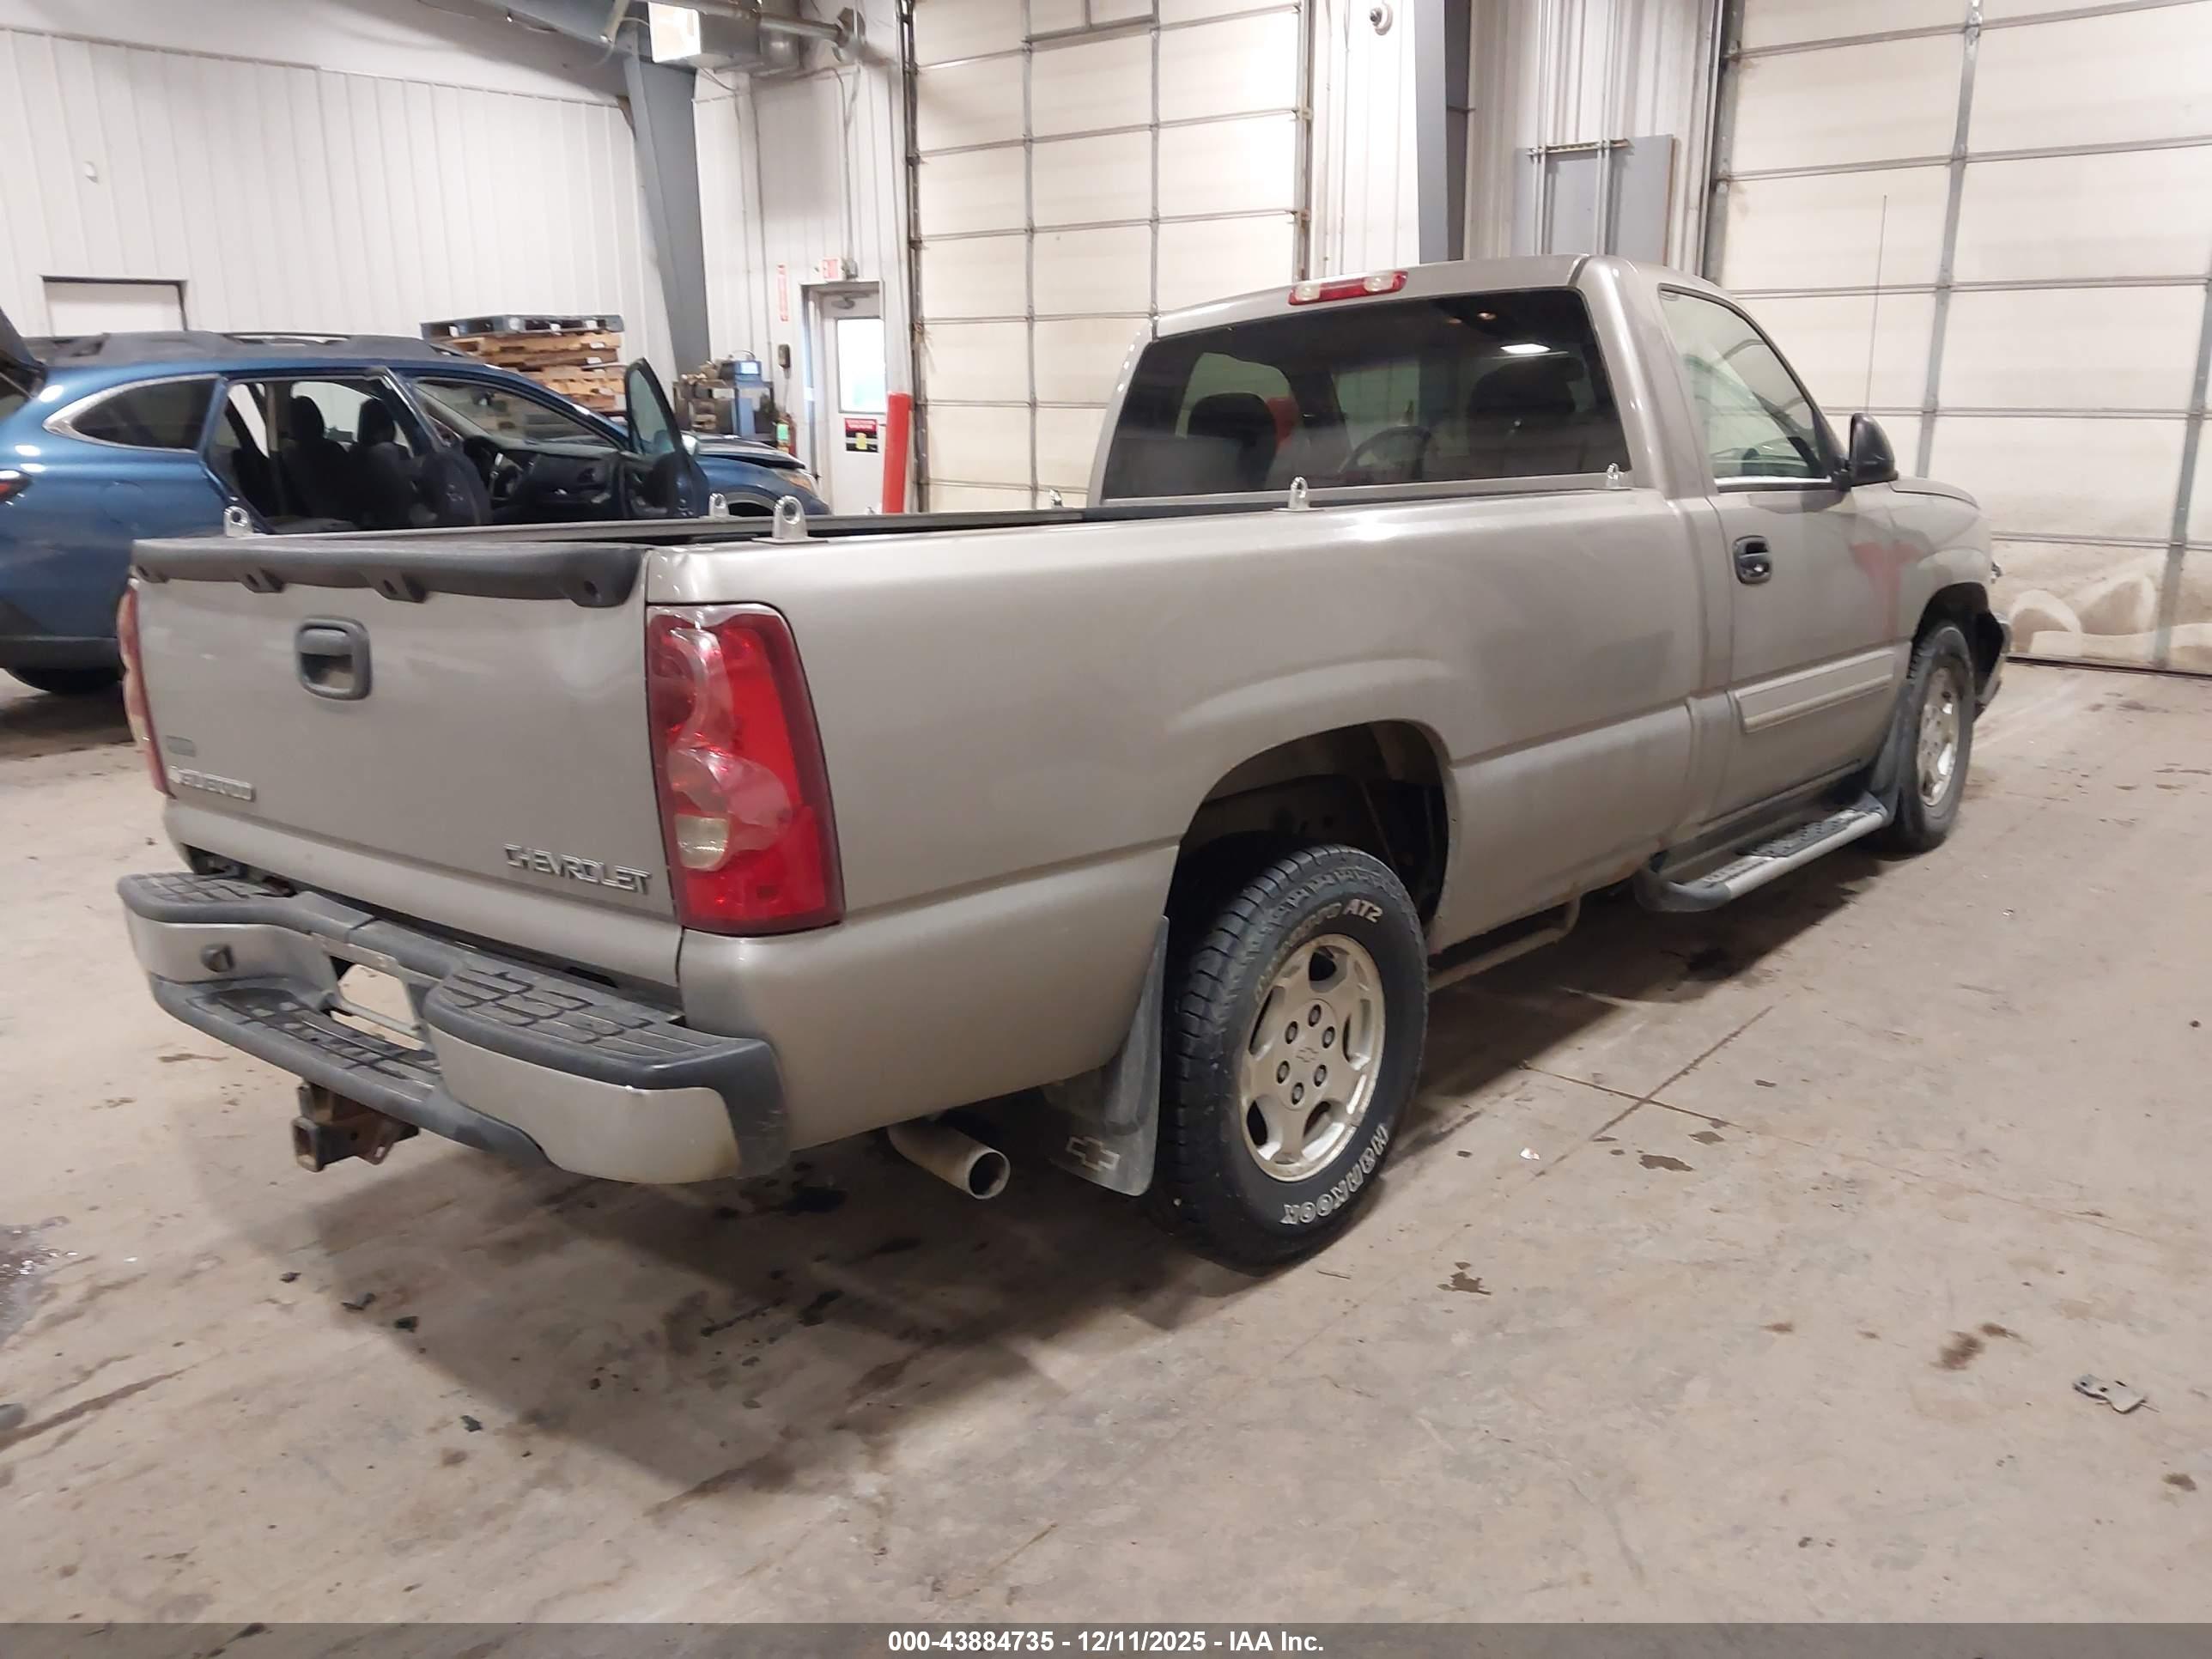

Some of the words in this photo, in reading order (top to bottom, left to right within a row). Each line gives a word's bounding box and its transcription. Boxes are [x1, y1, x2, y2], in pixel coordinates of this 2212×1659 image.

[503, 842, 652, 895] CHEVROLET
[1342, 898, 1383, 924] AT2
[1279, 1124, 1389, 1225] HANKOOK
